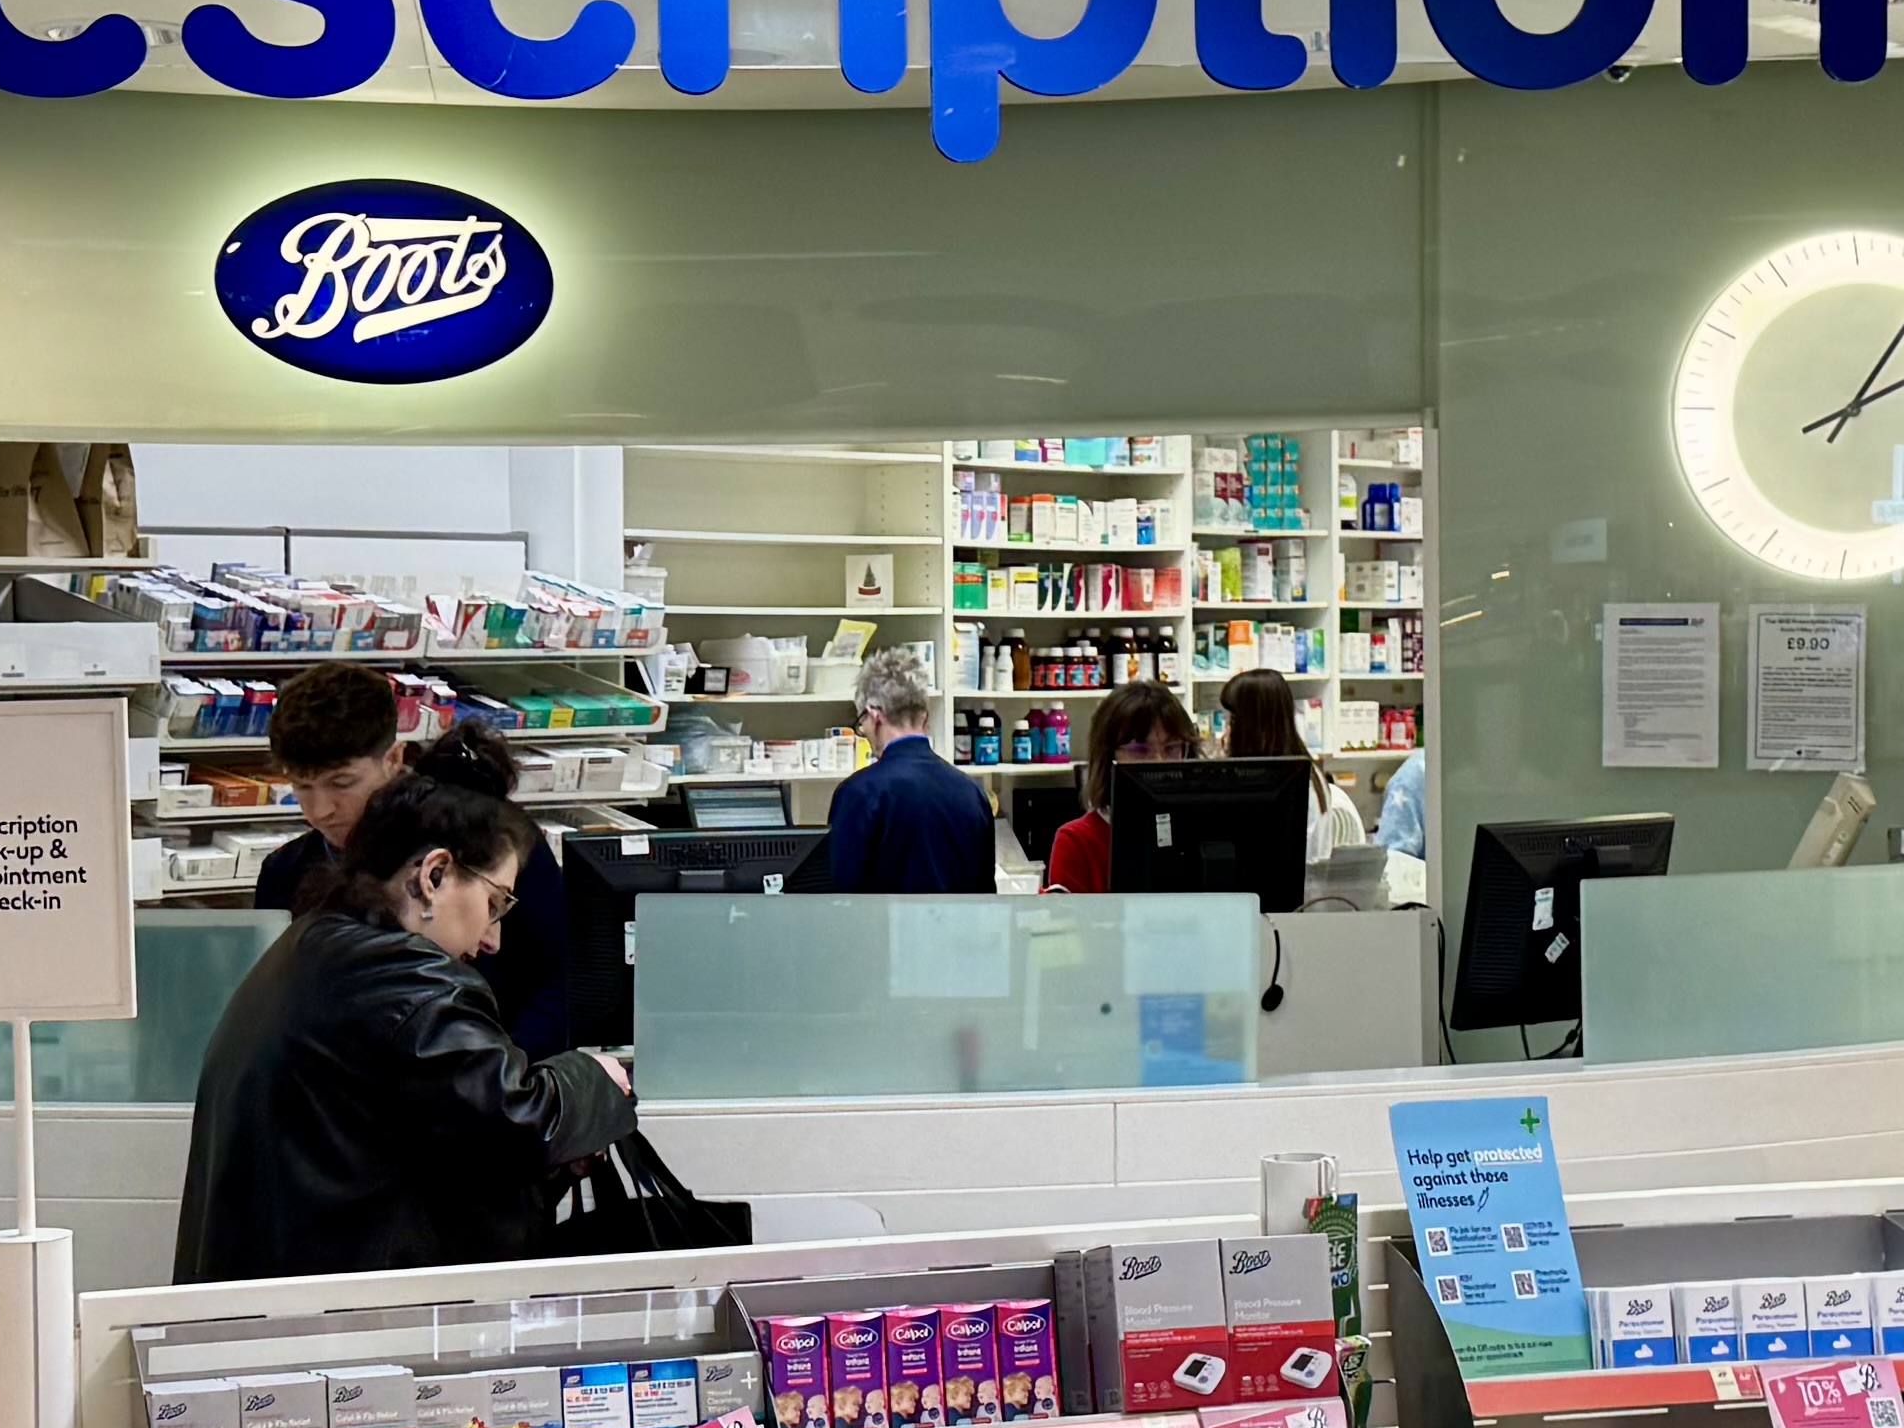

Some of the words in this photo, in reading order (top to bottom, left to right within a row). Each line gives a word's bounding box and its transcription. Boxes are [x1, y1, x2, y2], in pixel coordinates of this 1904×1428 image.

[251, 212, 506, 342] Boots
[1788, 637, 1829, 650] £9.90
[50, 839, 67, 859] &
[1407, 1149, 1442, 1168] Help
[1448, 1150, 1471, 1168] get
[1474, 1144, 1542, 1166] protected
[1413, 1170, 1467, 1190] against
[1417, 1193, 1474, 1209] illnesses
[1119, 1256, 1161, 1280] Boots
[1798, 1380, 1840, 1407] 10%
